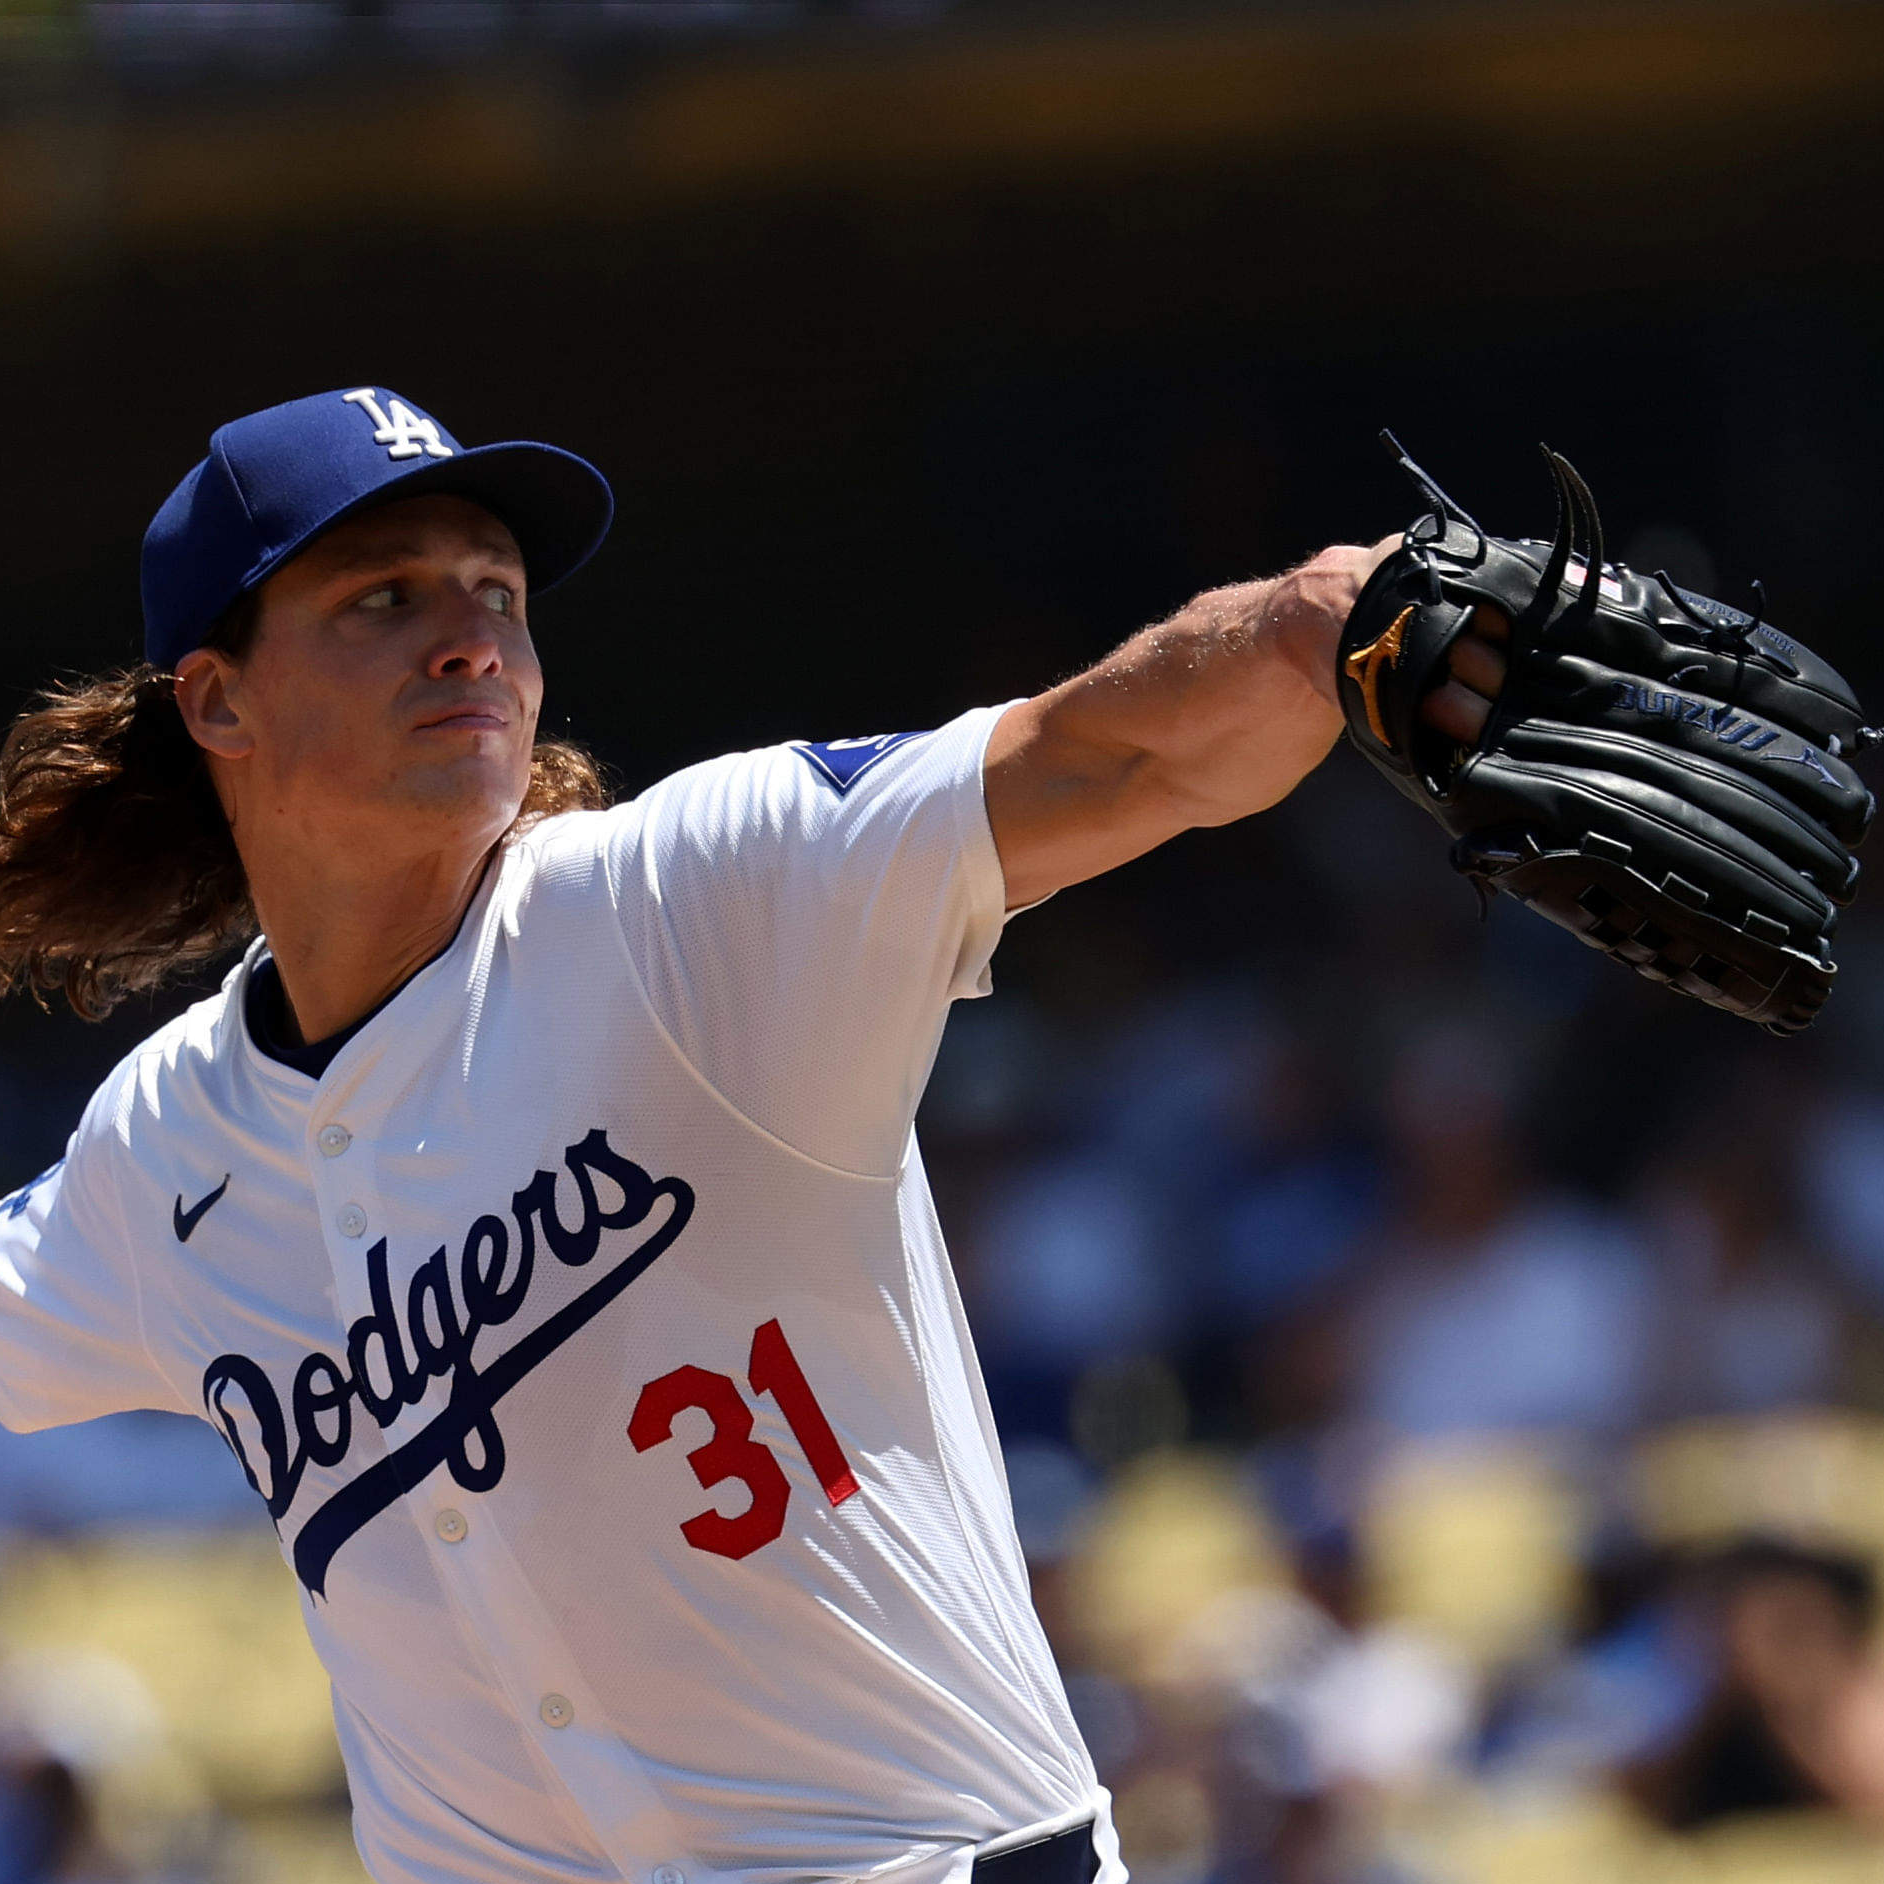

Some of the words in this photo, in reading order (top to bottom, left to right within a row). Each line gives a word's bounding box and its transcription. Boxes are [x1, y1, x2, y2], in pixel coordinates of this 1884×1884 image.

[342, 388, 453, 459] LA
[203, 1127, 695, 1602] Dodgers
[626, 1317, 860, 1561] 31
